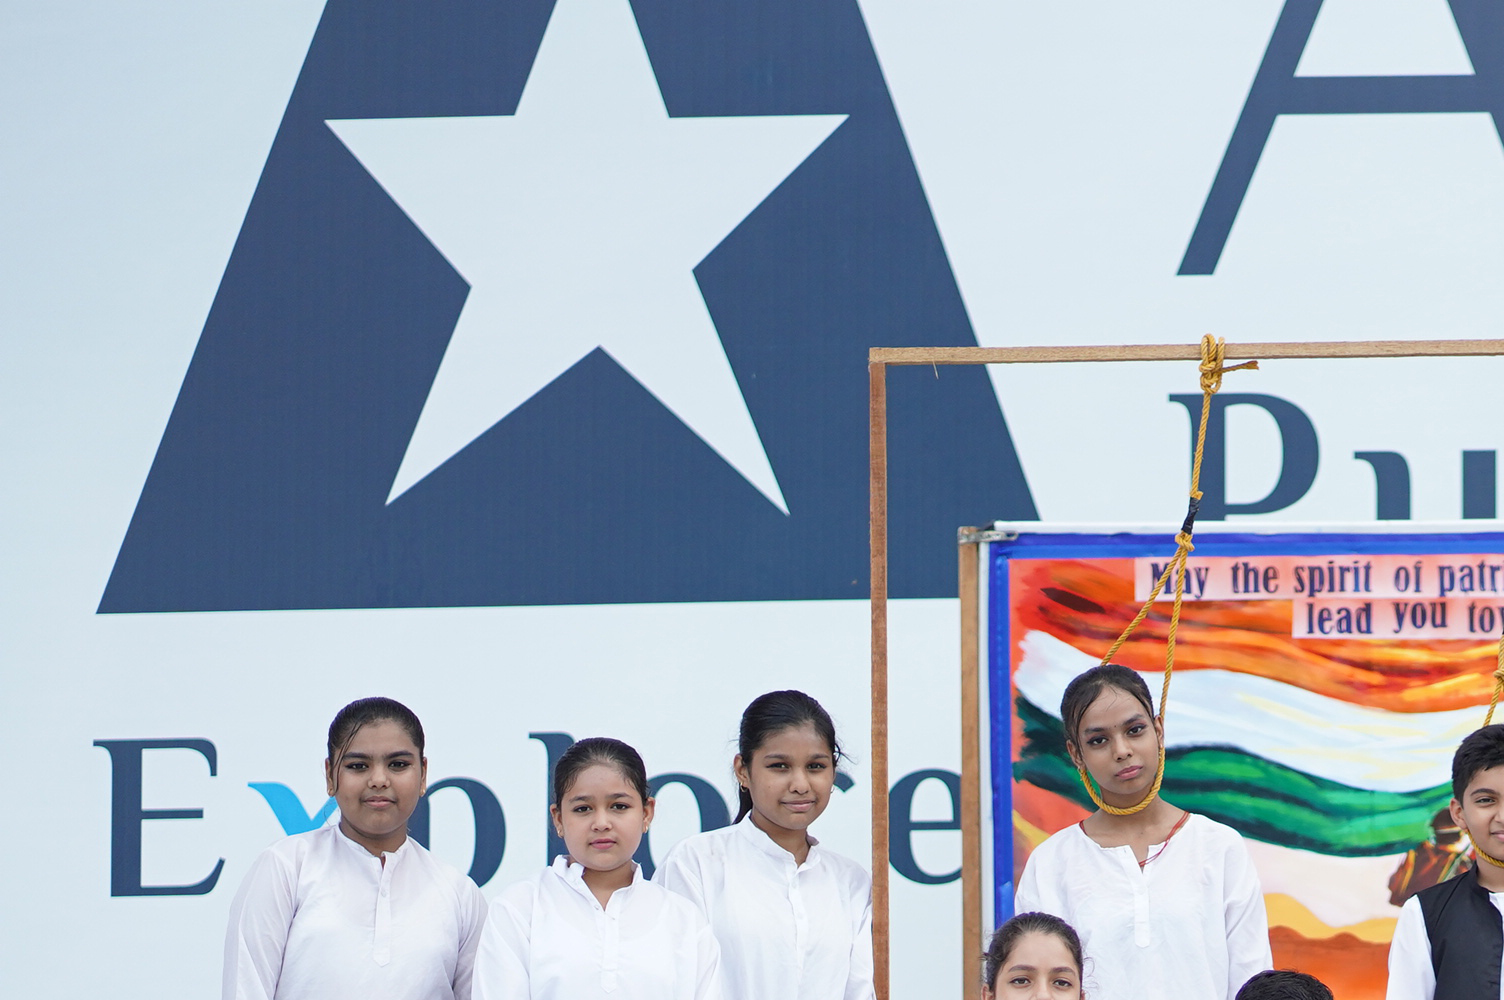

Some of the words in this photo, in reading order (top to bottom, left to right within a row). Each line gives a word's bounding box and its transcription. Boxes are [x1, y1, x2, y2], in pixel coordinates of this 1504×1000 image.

[1151, 562, 1209, 599] May
[1232, 562, 1279, 594] the
[1294, 560, 1372, 598] spirit
[1395, 561, 1422, 593] of
[1306, 602, 1373, 635] lead
[1393, 601, 1447, 634] you
